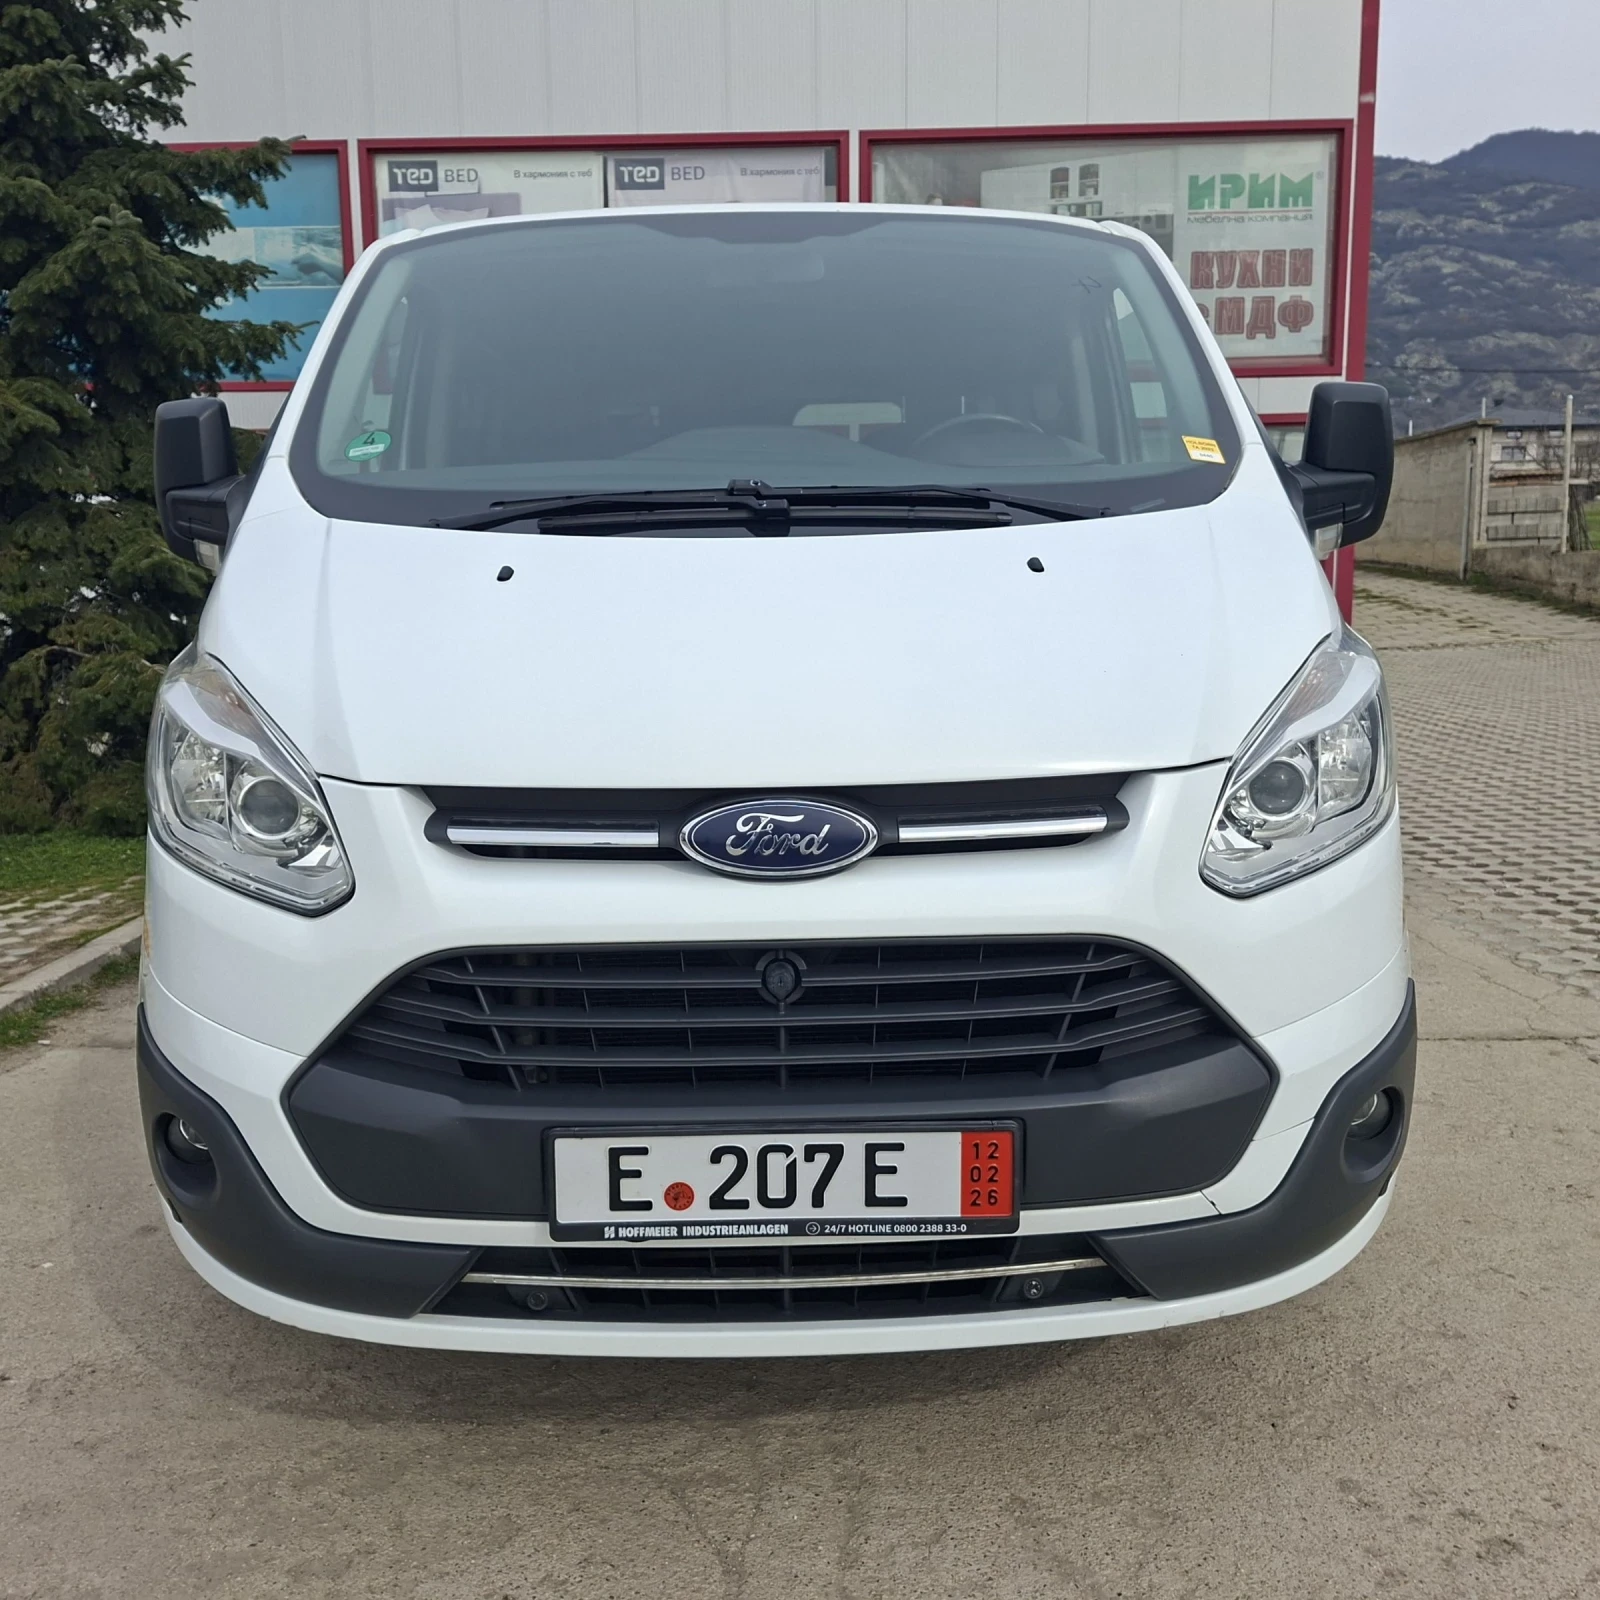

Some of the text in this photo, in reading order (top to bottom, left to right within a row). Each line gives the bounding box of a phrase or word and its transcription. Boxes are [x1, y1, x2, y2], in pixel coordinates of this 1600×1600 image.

[444, 168, 478, 183] BED
[513, 169, 521, 179] В
[522, 170, 568, 181] хармония
[671, 166, 705, 181] BED
[1187, 172, 1314, 210] ИРИМ
[1190, 248, 1313, 289] КУХНИ
[1214, 295, 1314, 340] МДФ
[725, 812, 831, 856] Ford
[972, 1141, 999, 1160] 12
[607, 1141, 908, 1211] E 207 E
[970, 1165, 999, 1183] 02
[970, 1188, 999, 1206] 26
[618, 1224, 789, 1237] HOFFMEIER INDUSTRIEANLAGEN
[824, 1223, 967, 1235] 24/7 HOTLINE 0800 2388 33-0
